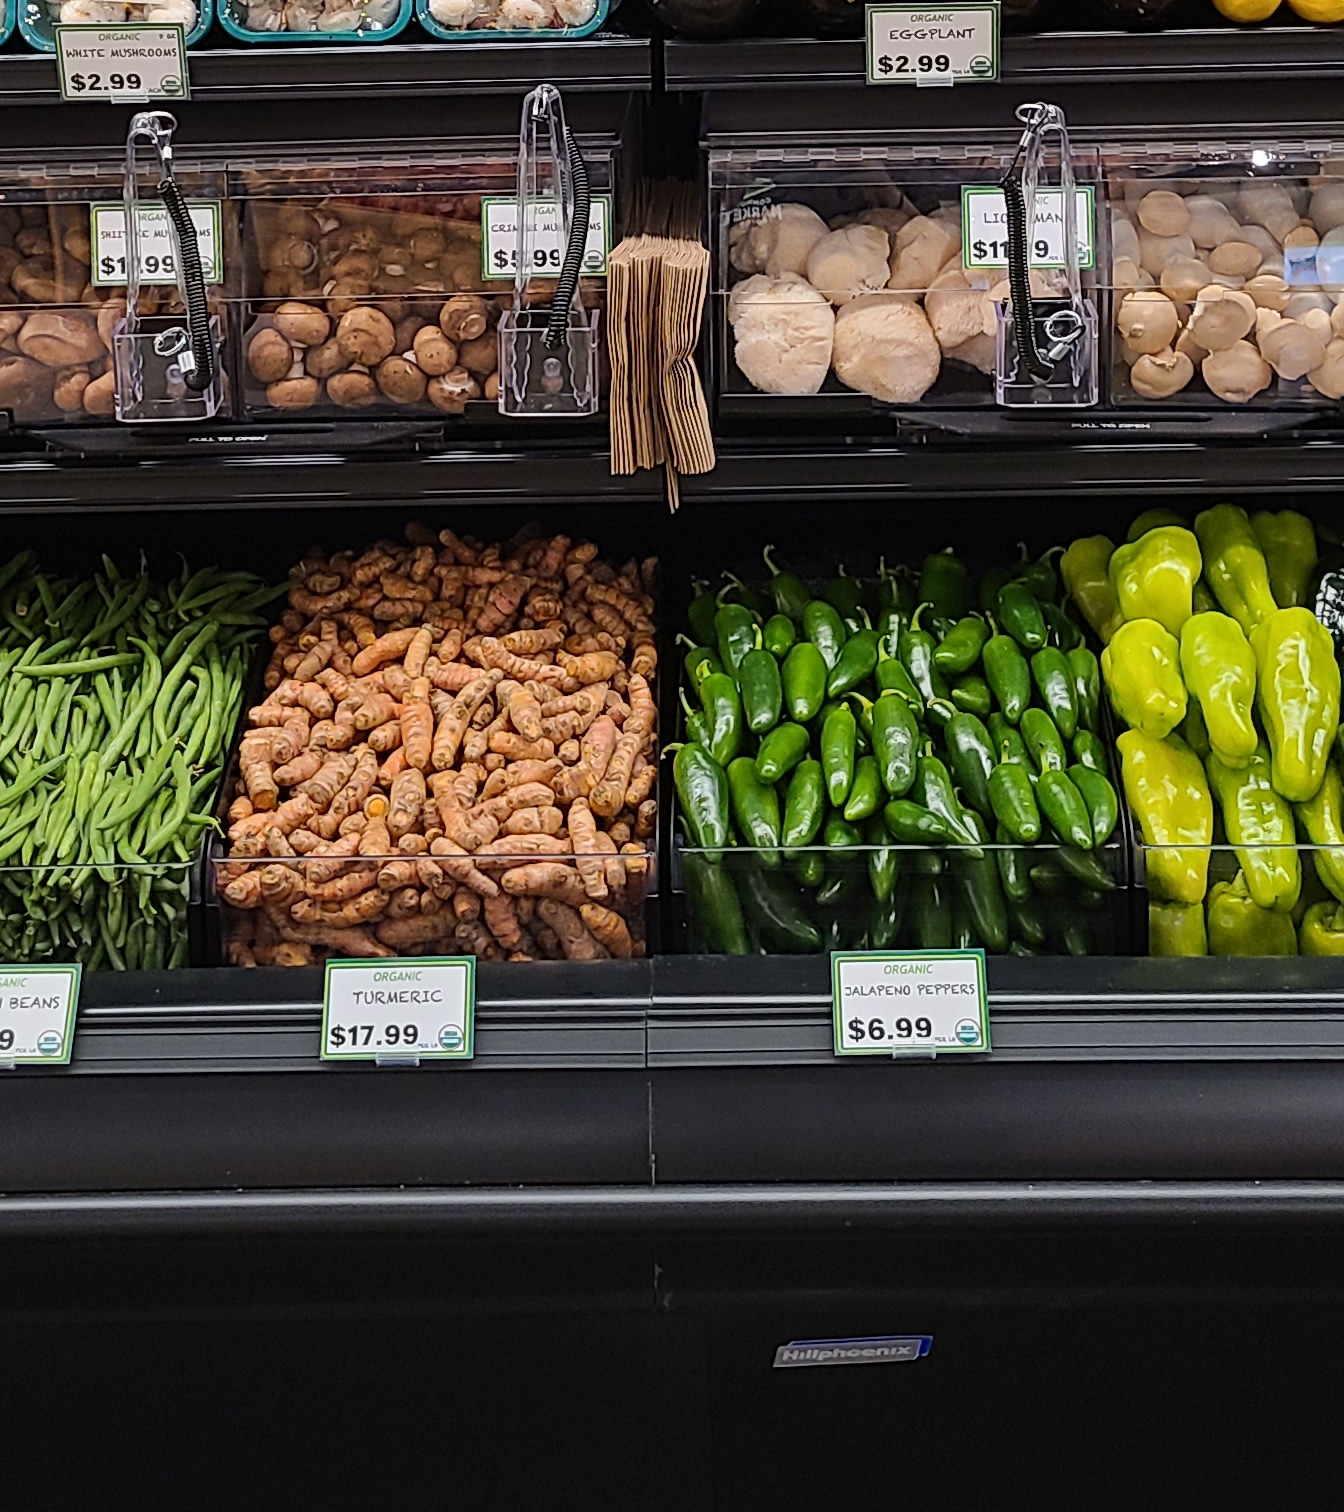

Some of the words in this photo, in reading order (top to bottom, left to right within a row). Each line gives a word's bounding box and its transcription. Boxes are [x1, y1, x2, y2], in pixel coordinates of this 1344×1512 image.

[889, 28, 975, 40] EGGPLANT
[65, 46, 106, 60] WHITE
[111, 46, 177, 59] MUSHROOMS
[878, 55, 950, 75] $2.99
[70, 72, 142, 93] $2.99
[884, 964, 933, 975] ORGANIC
[353, 990, 443, 1005] TURMERIC
[845, 985, 911, 997] JALAPENO
[917, 984, 976, 995] PEPPERS
[9, 996, 60, 1009] BEANS
[330, 1024, 419, 1048] $17.99
[848, 1017, 932, 1042] $6.99
[782, 1346, 911, 1361] Hillphoenix
